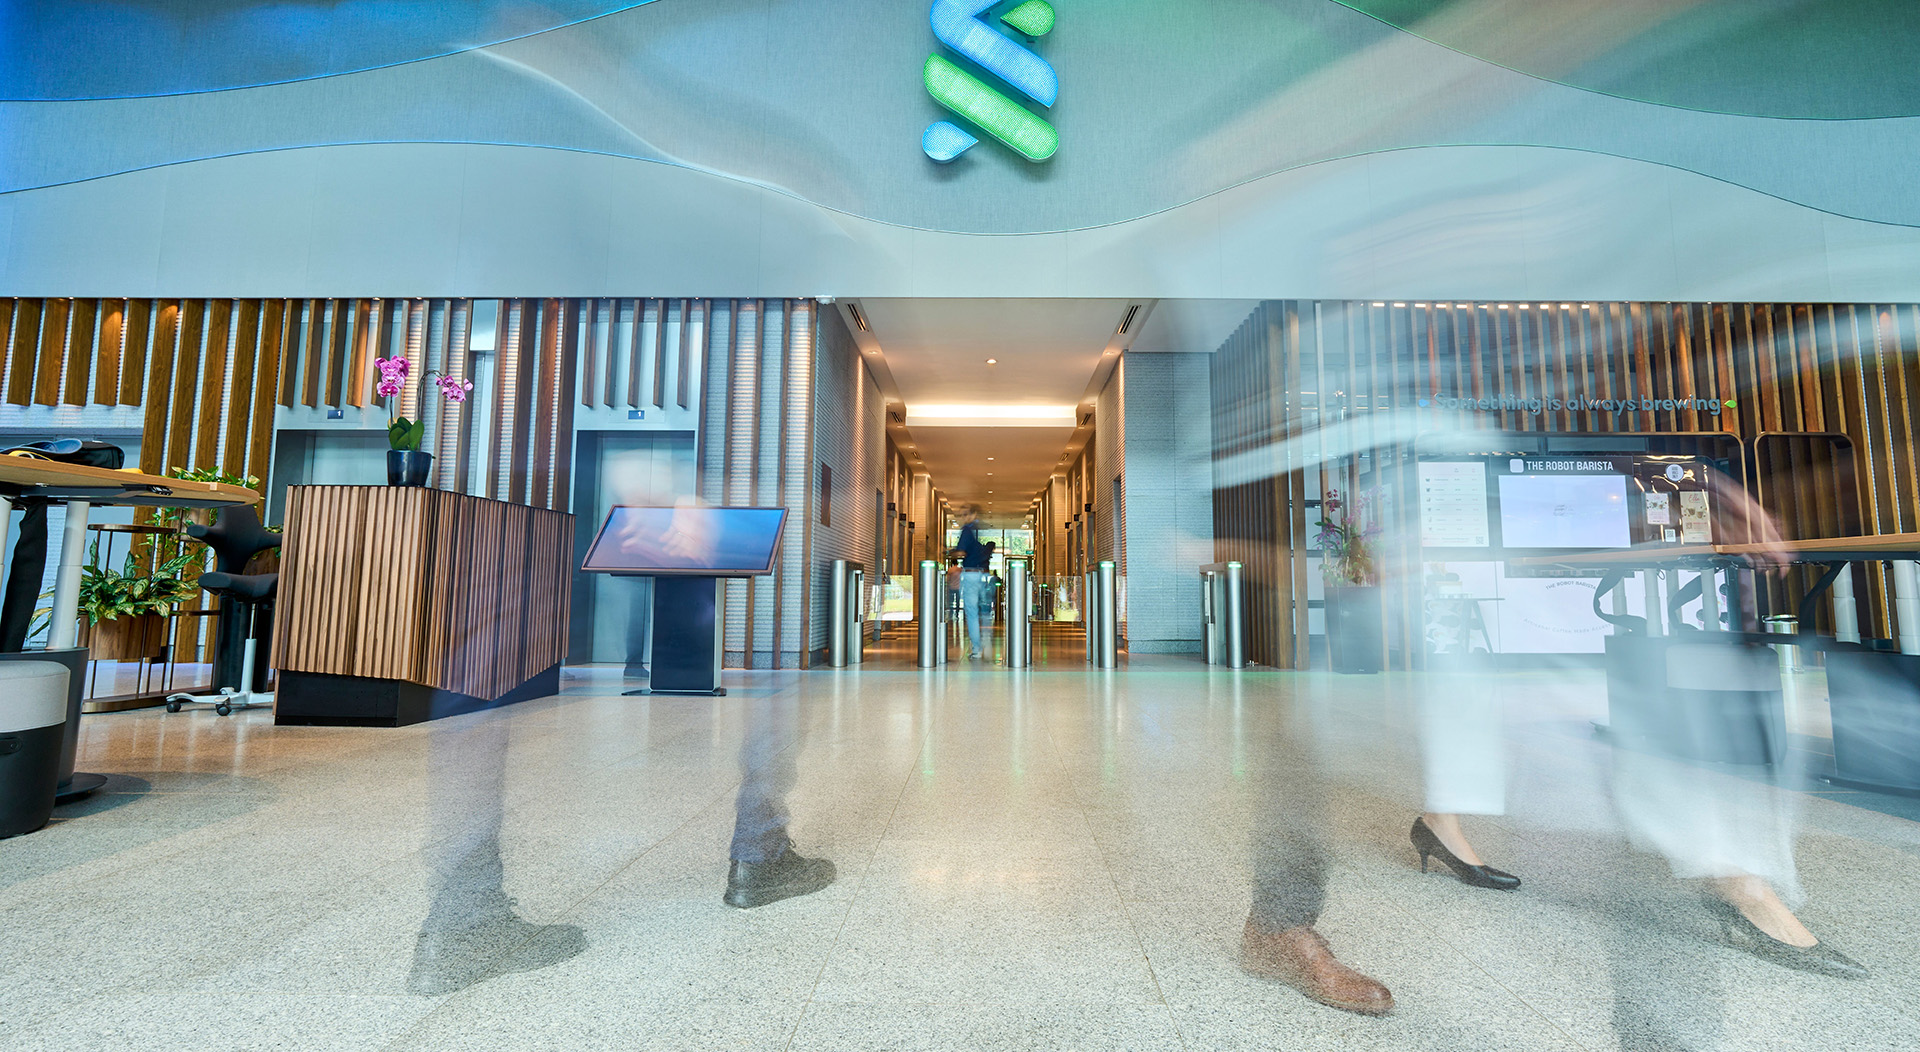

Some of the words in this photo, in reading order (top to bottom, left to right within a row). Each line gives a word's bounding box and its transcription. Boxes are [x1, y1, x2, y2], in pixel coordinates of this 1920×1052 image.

[1434, 393, 1542, 415] Something
[1547, 394, 1562, 411] is
[1566, 394, 1637, 416] always
[1641, 394, 1721, 416] brewing
[1526, 461, 1543, 471] THE
[1545, 461, 1575, 471] ROBOT
[1576, 461, 1614, 471] BARISTA
